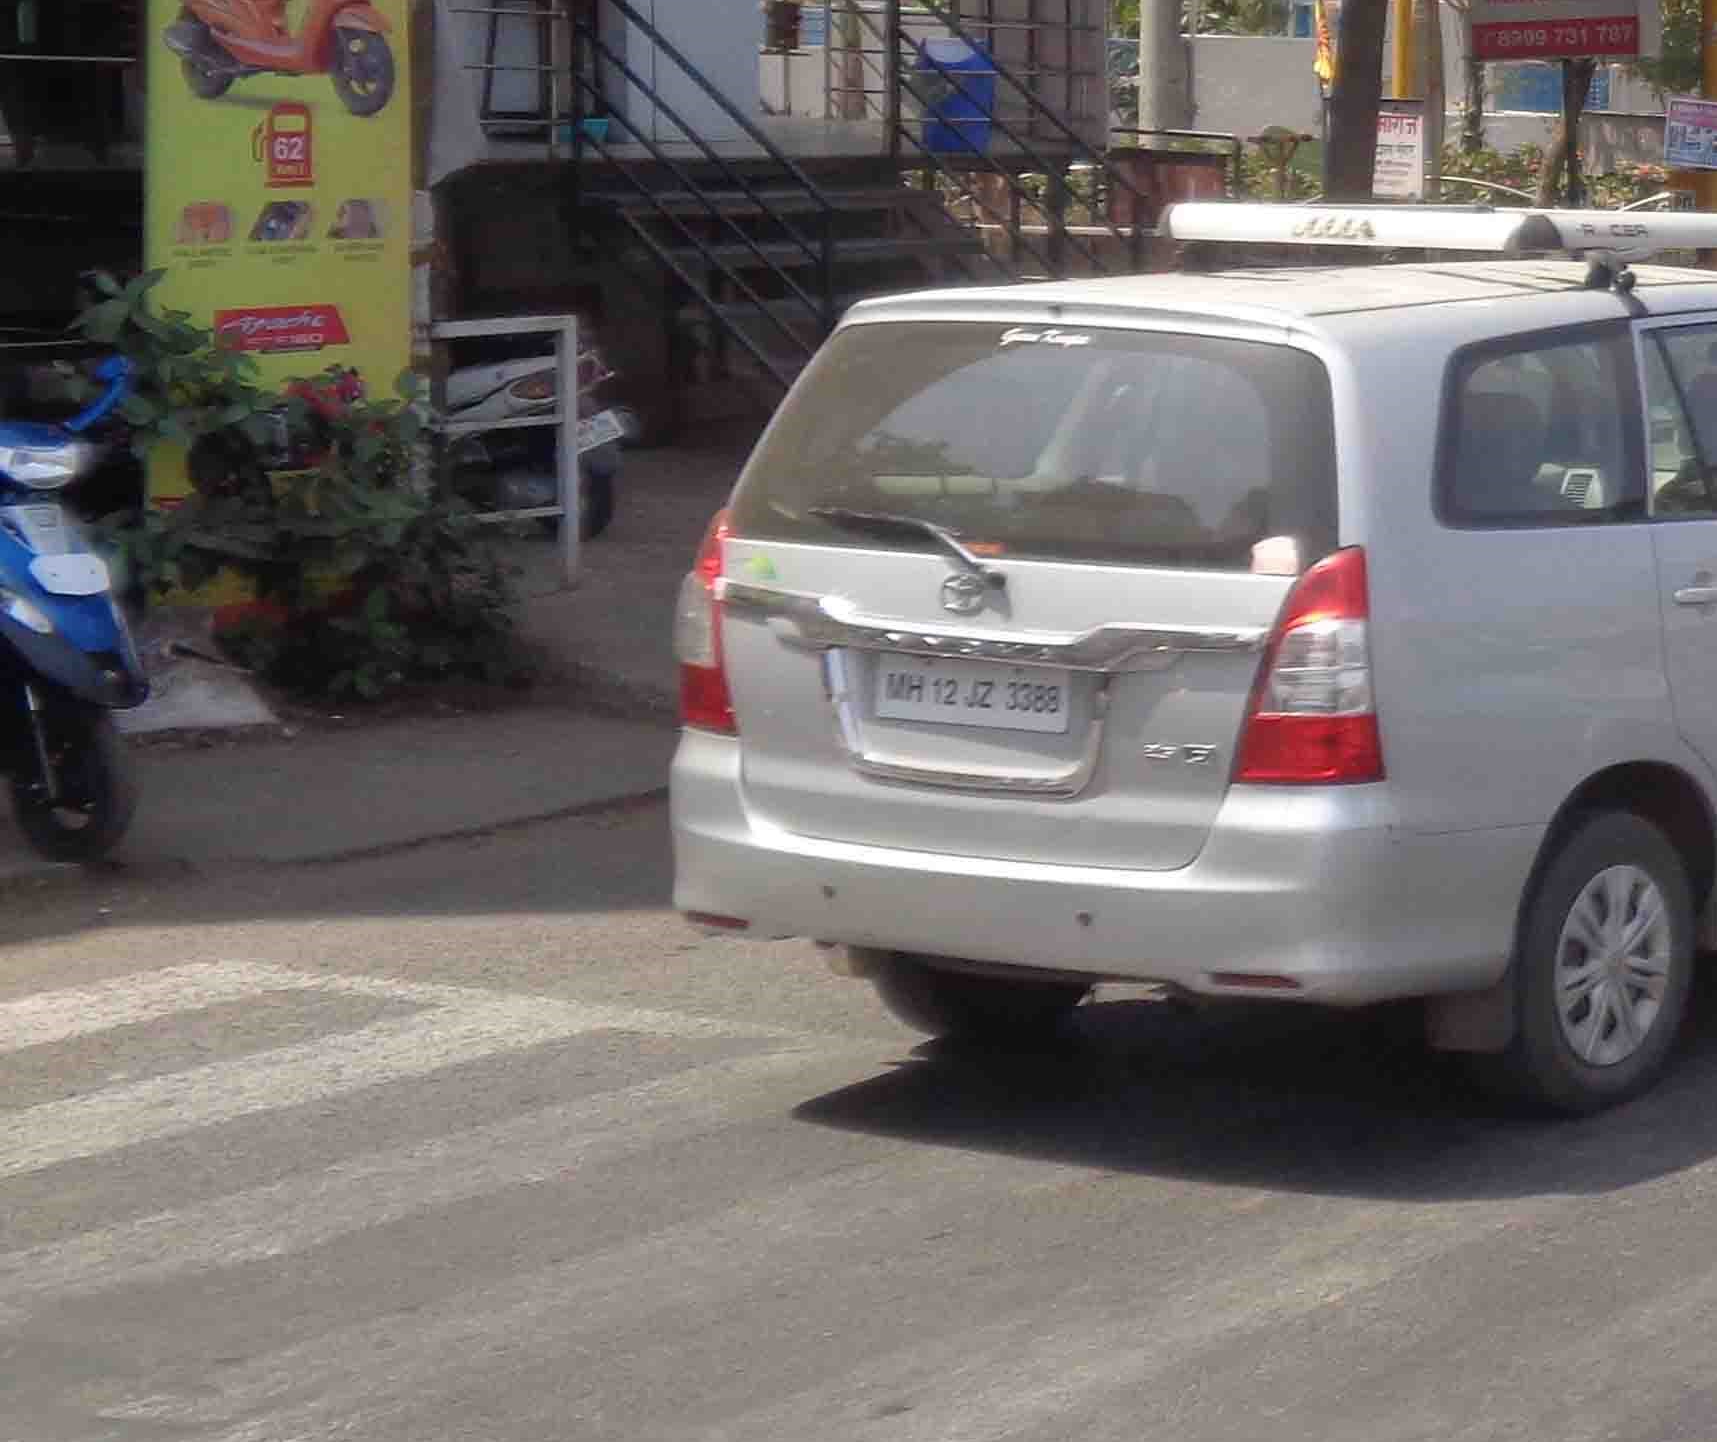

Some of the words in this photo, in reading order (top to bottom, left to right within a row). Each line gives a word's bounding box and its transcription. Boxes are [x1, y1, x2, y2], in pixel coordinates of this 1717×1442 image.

[272, 136, 305, 161] 62
[887, 672, 924, 703] MH
[932, 677, 958, 706] 12
[963, 680, 996, 709] JZ
